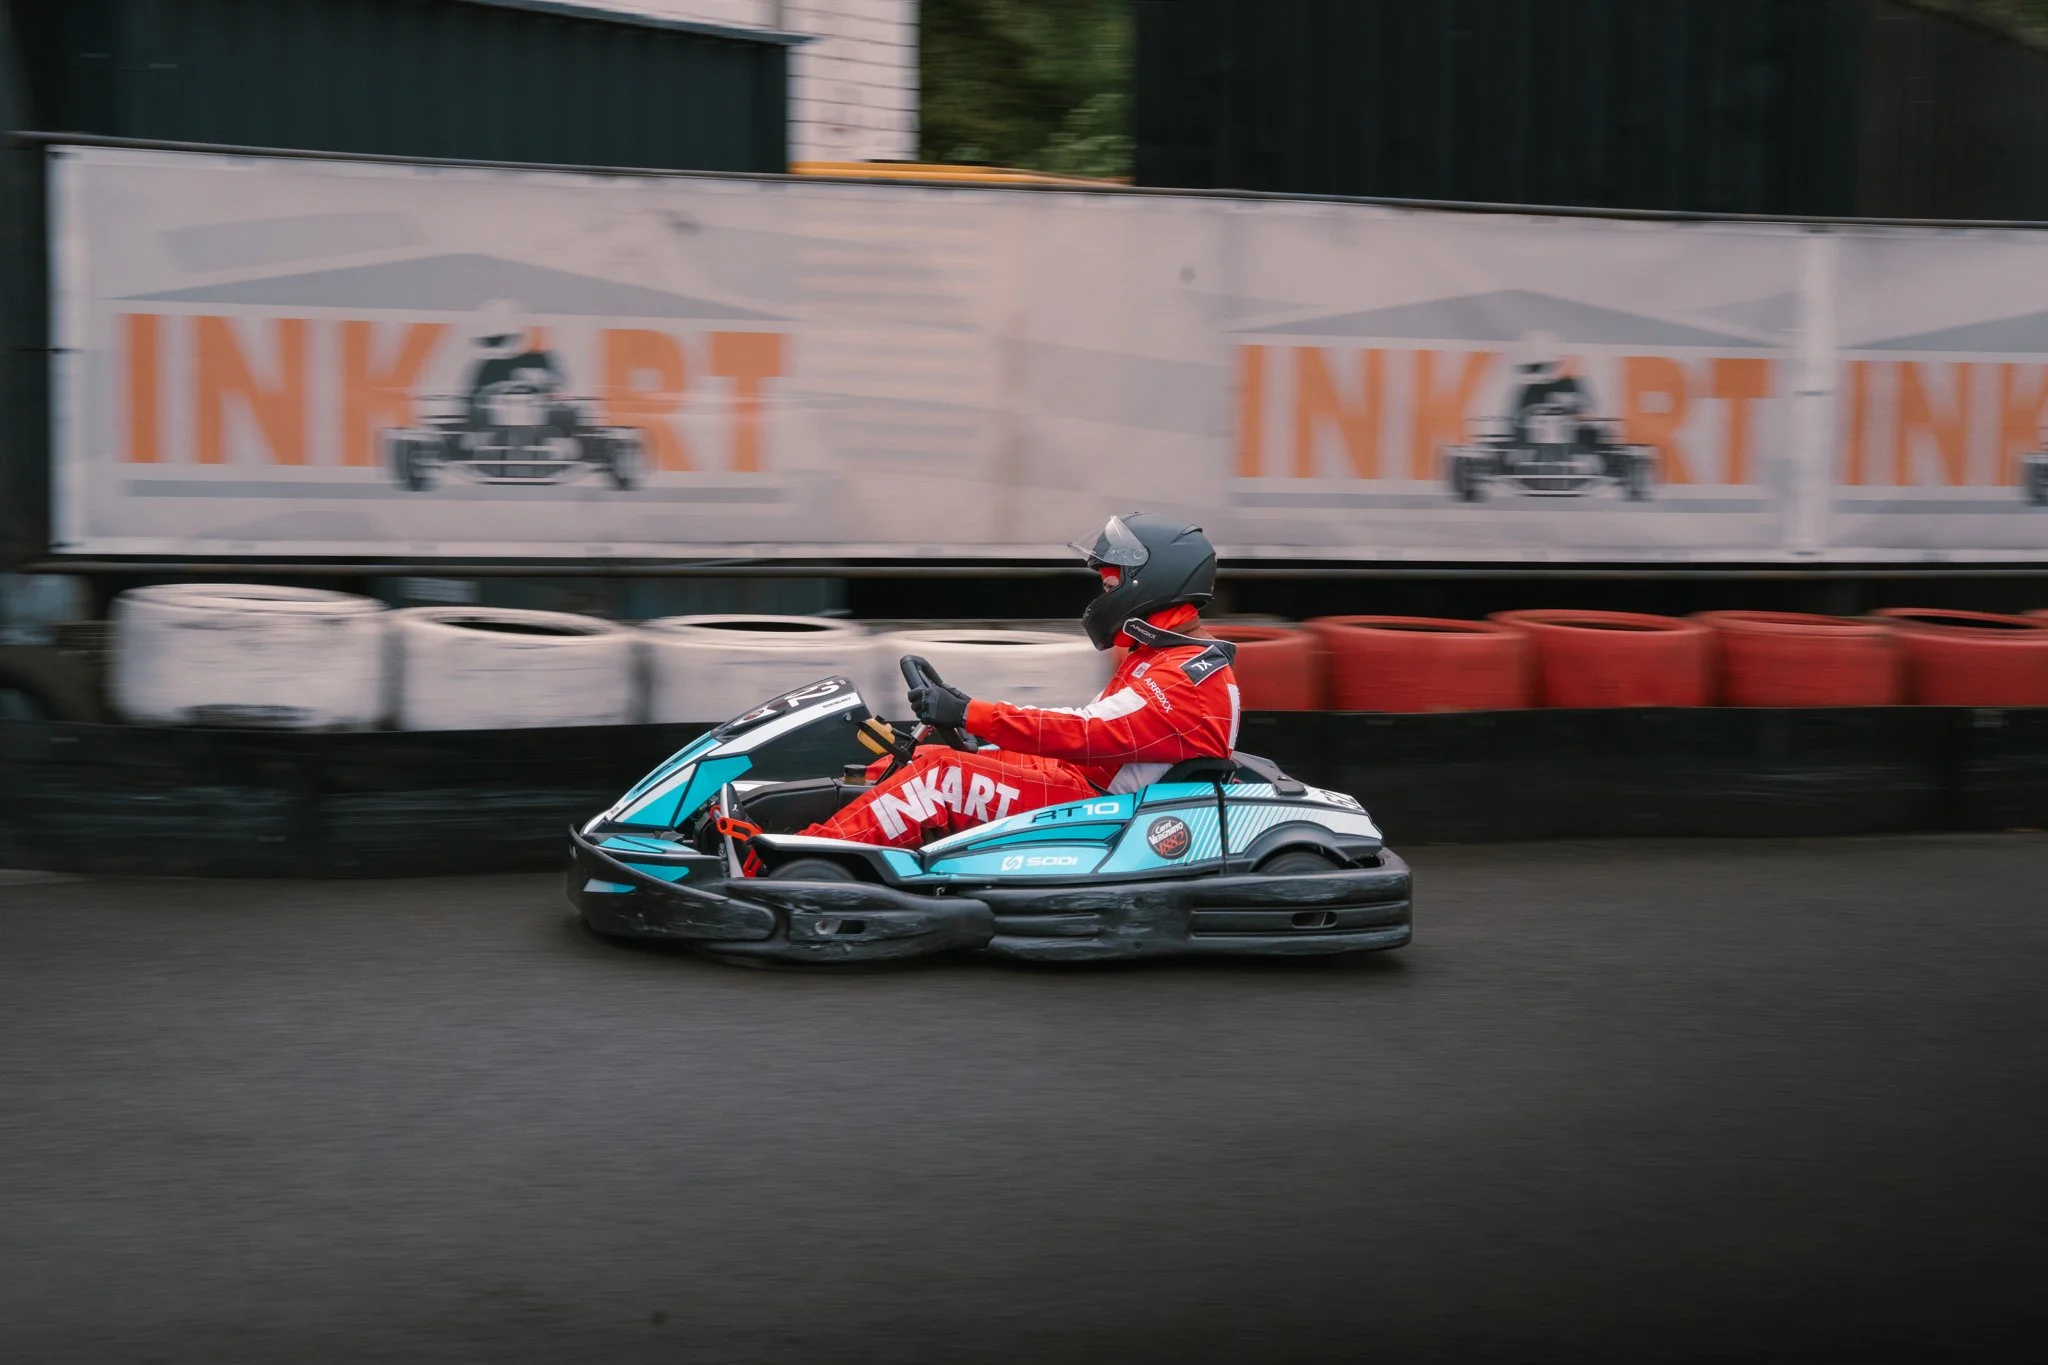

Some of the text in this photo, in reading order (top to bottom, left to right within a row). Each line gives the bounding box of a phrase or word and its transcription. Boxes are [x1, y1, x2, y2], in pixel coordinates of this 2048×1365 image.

[118, 313, 792, 474] INKRT
[1233, 344, 1772, 487] INKRT
[1191, 660, 1212, 672] TX
[1144, 677, 1173, 713] ARROXX
[870, 765, 1020, 841] INKART
[1031, 802, 1120, 823] RT10
[1159, 830, 1186, 856] 1882
[1025, 856, 1078, 867] SODI
